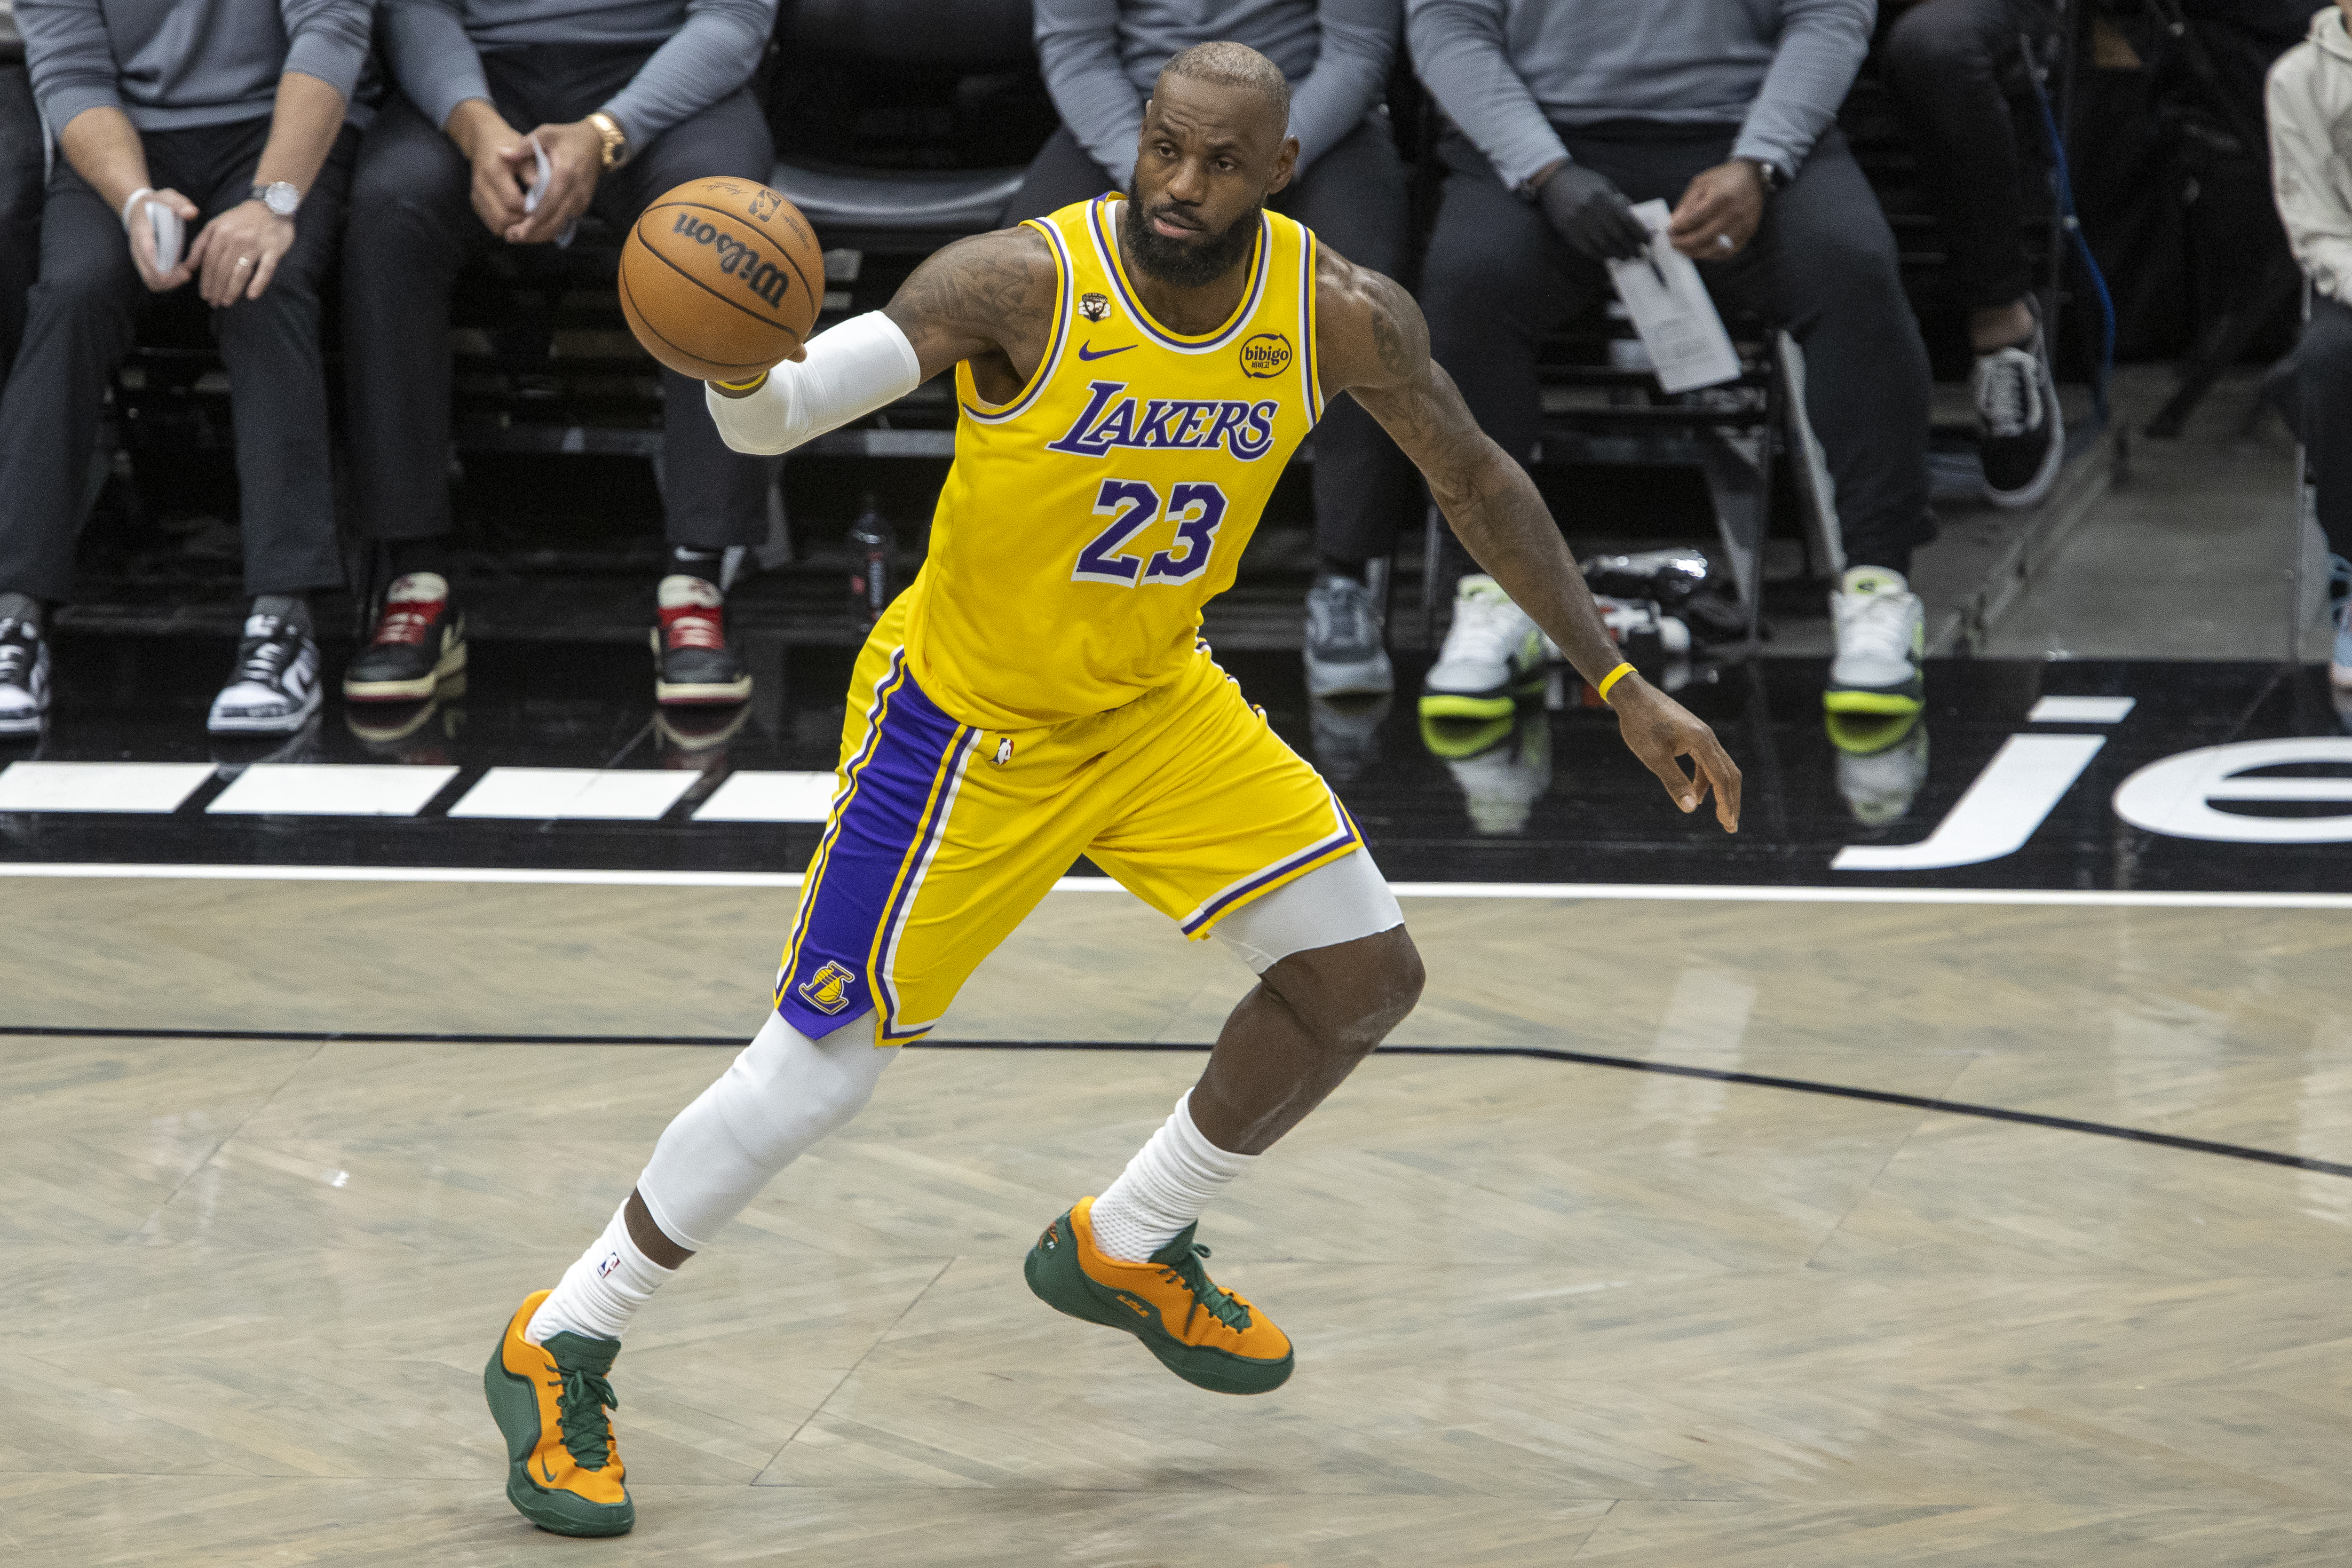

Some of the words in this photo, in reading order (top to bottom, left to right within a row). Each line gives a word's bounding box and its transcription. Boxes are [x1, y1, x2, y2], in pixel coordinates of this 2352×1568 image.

[673, 212, 789, 308] Wilson
[1245, 346, 1289, 366] bibigo
[1044, 379, 1280, 462] LAKERS
[1071, 478, 1229, 588] 23
